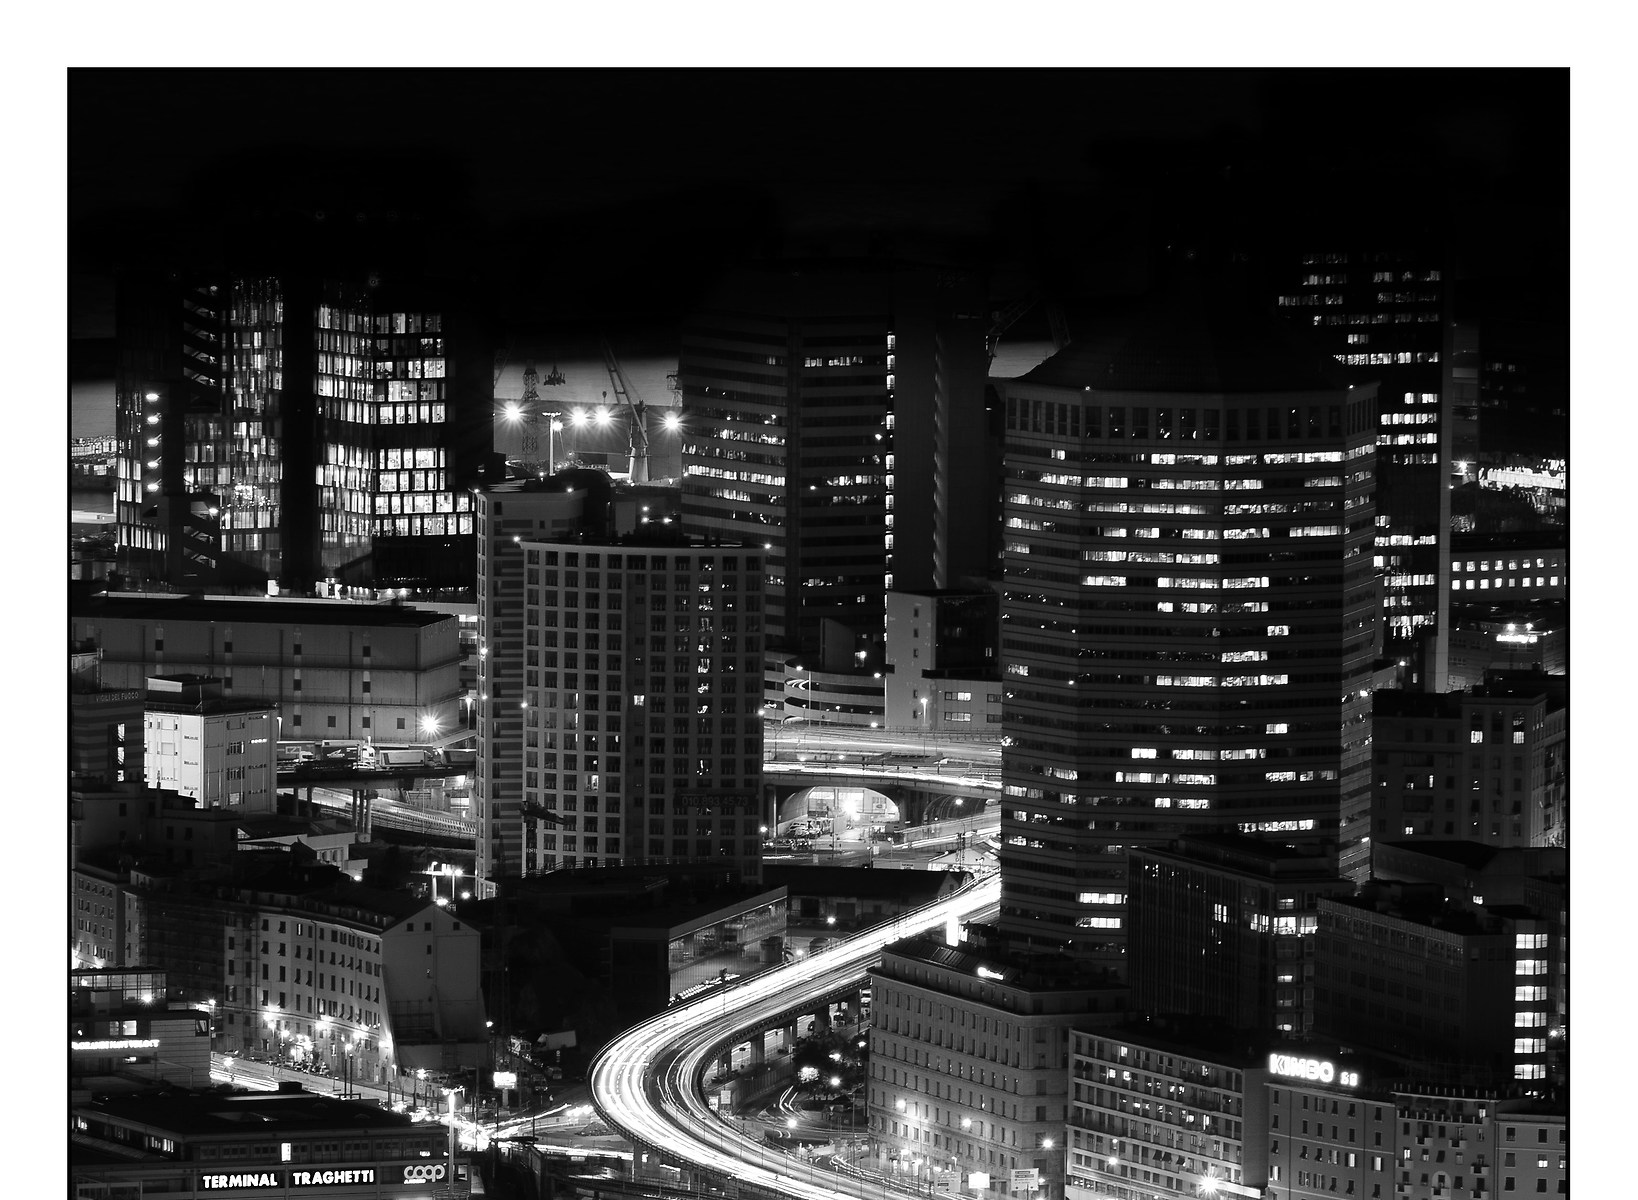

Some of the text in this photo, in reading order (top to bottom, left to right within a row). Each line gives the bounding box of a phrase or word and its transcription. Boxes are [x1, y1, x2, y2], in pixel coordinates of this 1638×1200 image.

[1269, 1053, 1335, 1083] KIMBO
[202, 1169, 374, 1188] TERMINAL TRAGHETTI
